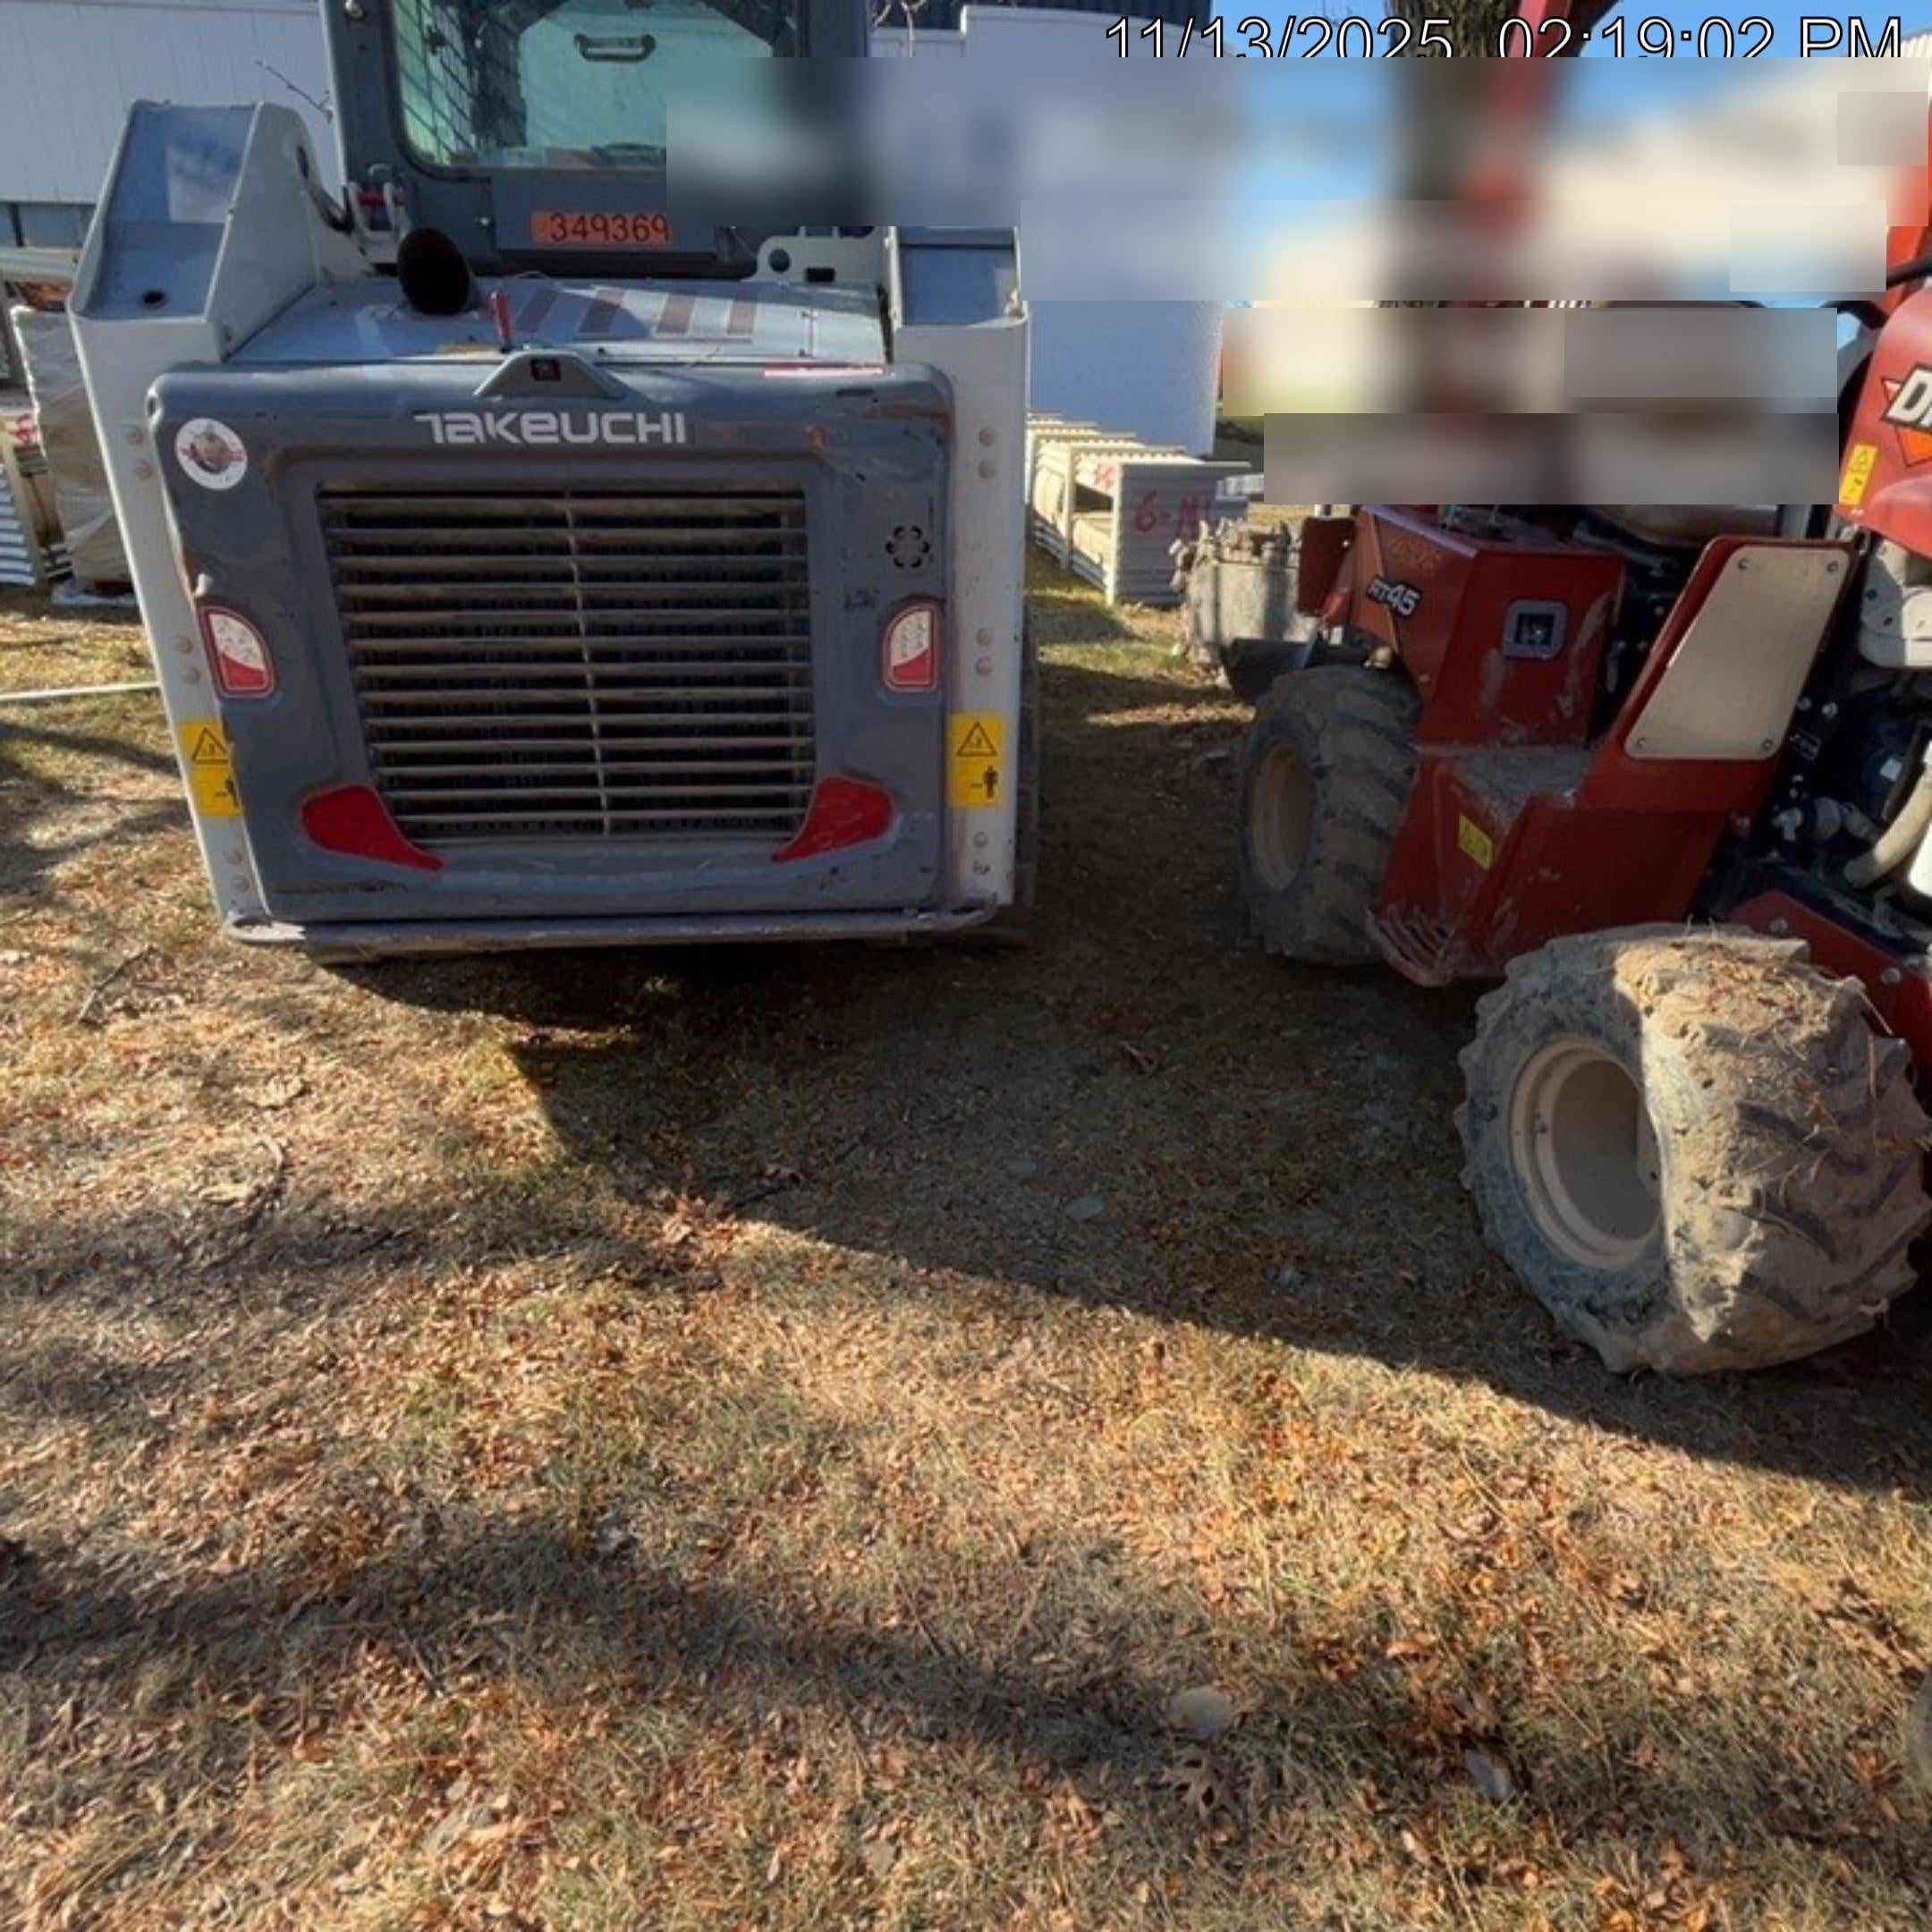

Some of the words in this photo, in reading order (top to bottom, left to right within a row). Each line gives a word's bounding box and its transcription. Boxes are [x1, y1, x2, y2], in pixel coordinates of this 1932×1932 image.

[549, 213, 669, 242] 349369
[1884, 365, 1932, 429] D
[414, 412, 687, 444] TAKEUCHI
